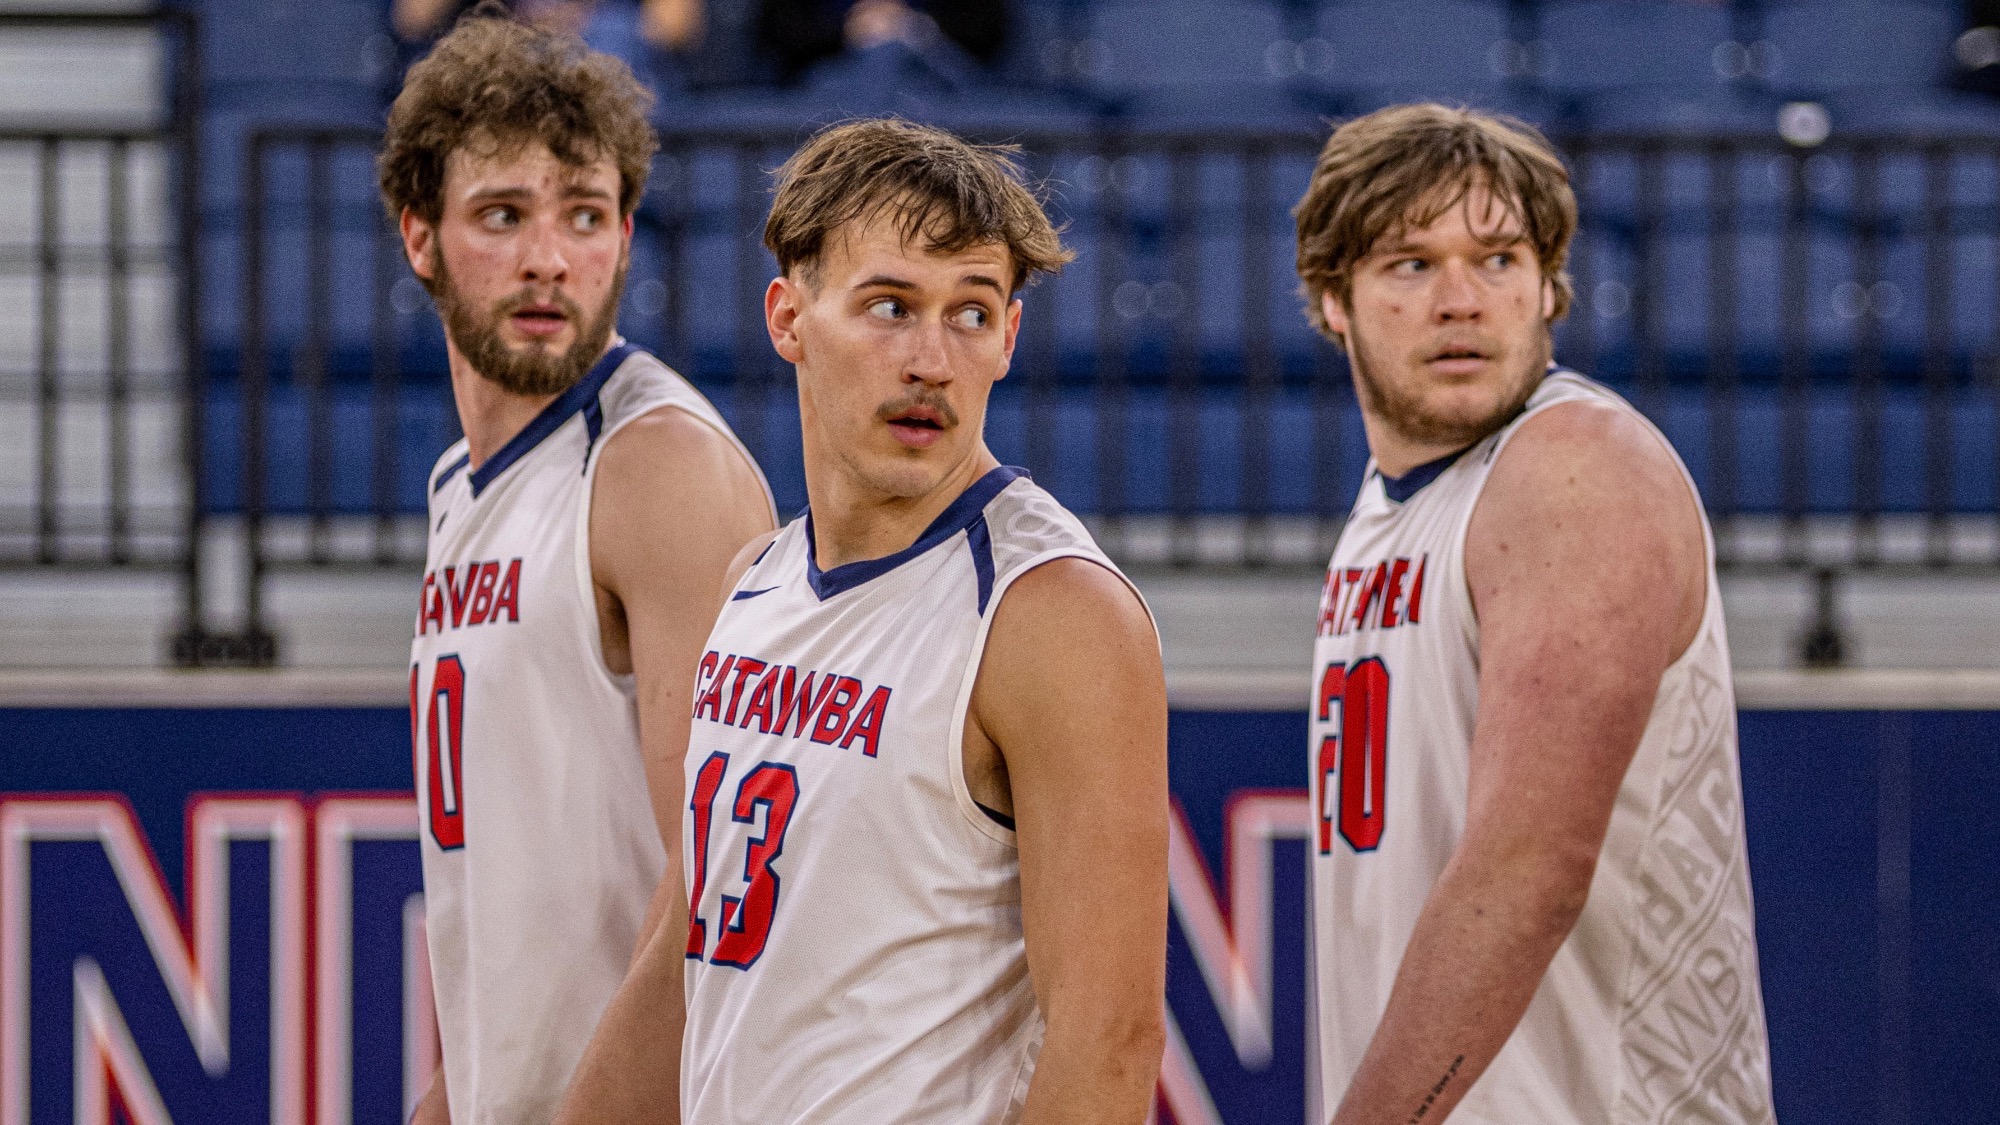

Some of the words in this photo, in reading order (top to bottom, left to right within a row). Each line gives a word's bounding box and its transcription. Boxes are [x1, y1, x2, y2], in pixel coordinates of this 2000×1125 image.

[692, 650, 893, 759] CATAWBA
[1318, 656, 1390, 855] 20
[685, 750, 801, 972] 13
